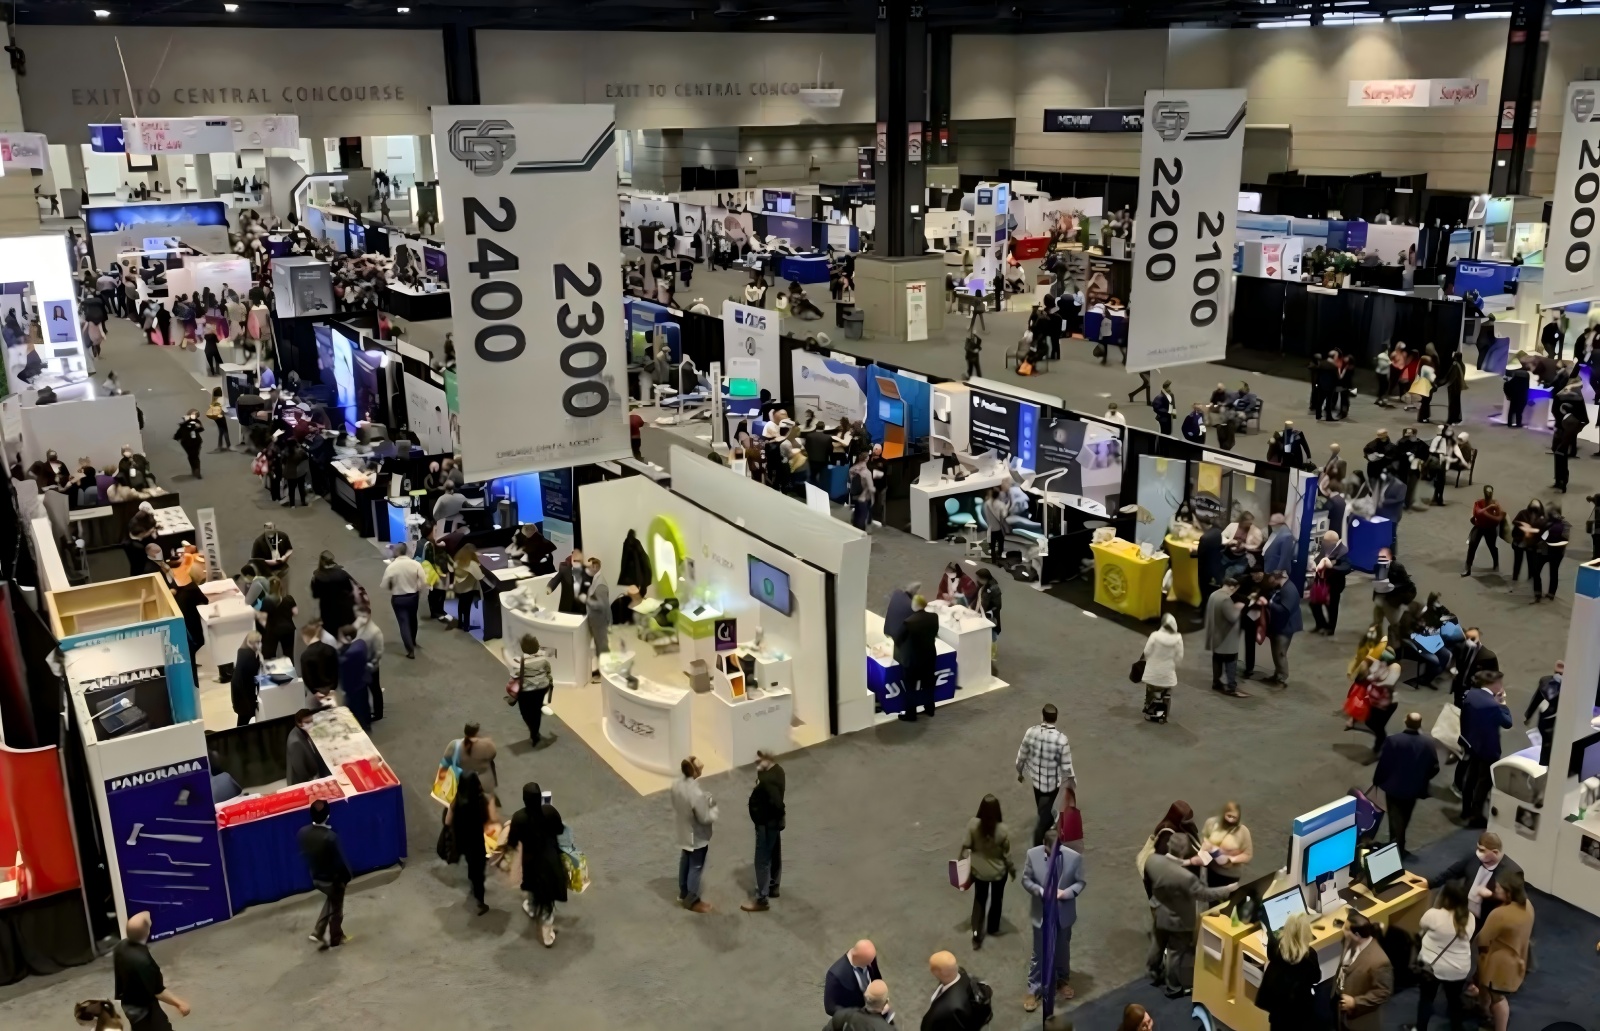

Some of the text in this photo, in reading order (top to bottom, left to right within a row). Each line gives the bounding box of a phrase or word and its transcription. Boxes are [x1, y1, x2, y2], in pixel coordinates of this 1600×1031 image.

[72, 85, 404, 106] EXIT TO CENTRAL CONCOURSE
[605, 83, 640, 98] EXIT
[648, 83, 667, 97] TO
[674, 82, 742, 97] CENTRAL
[1145, 156, 1184, 282] 2200
[1564, 138, 1600, 274] 2000
[461, 196, 527, 363] 2400
[1190, 210, 1225, 328] 2100
[553, 261, 610, 418] 2300
[111, 760, 202, 791] PANORAMA
